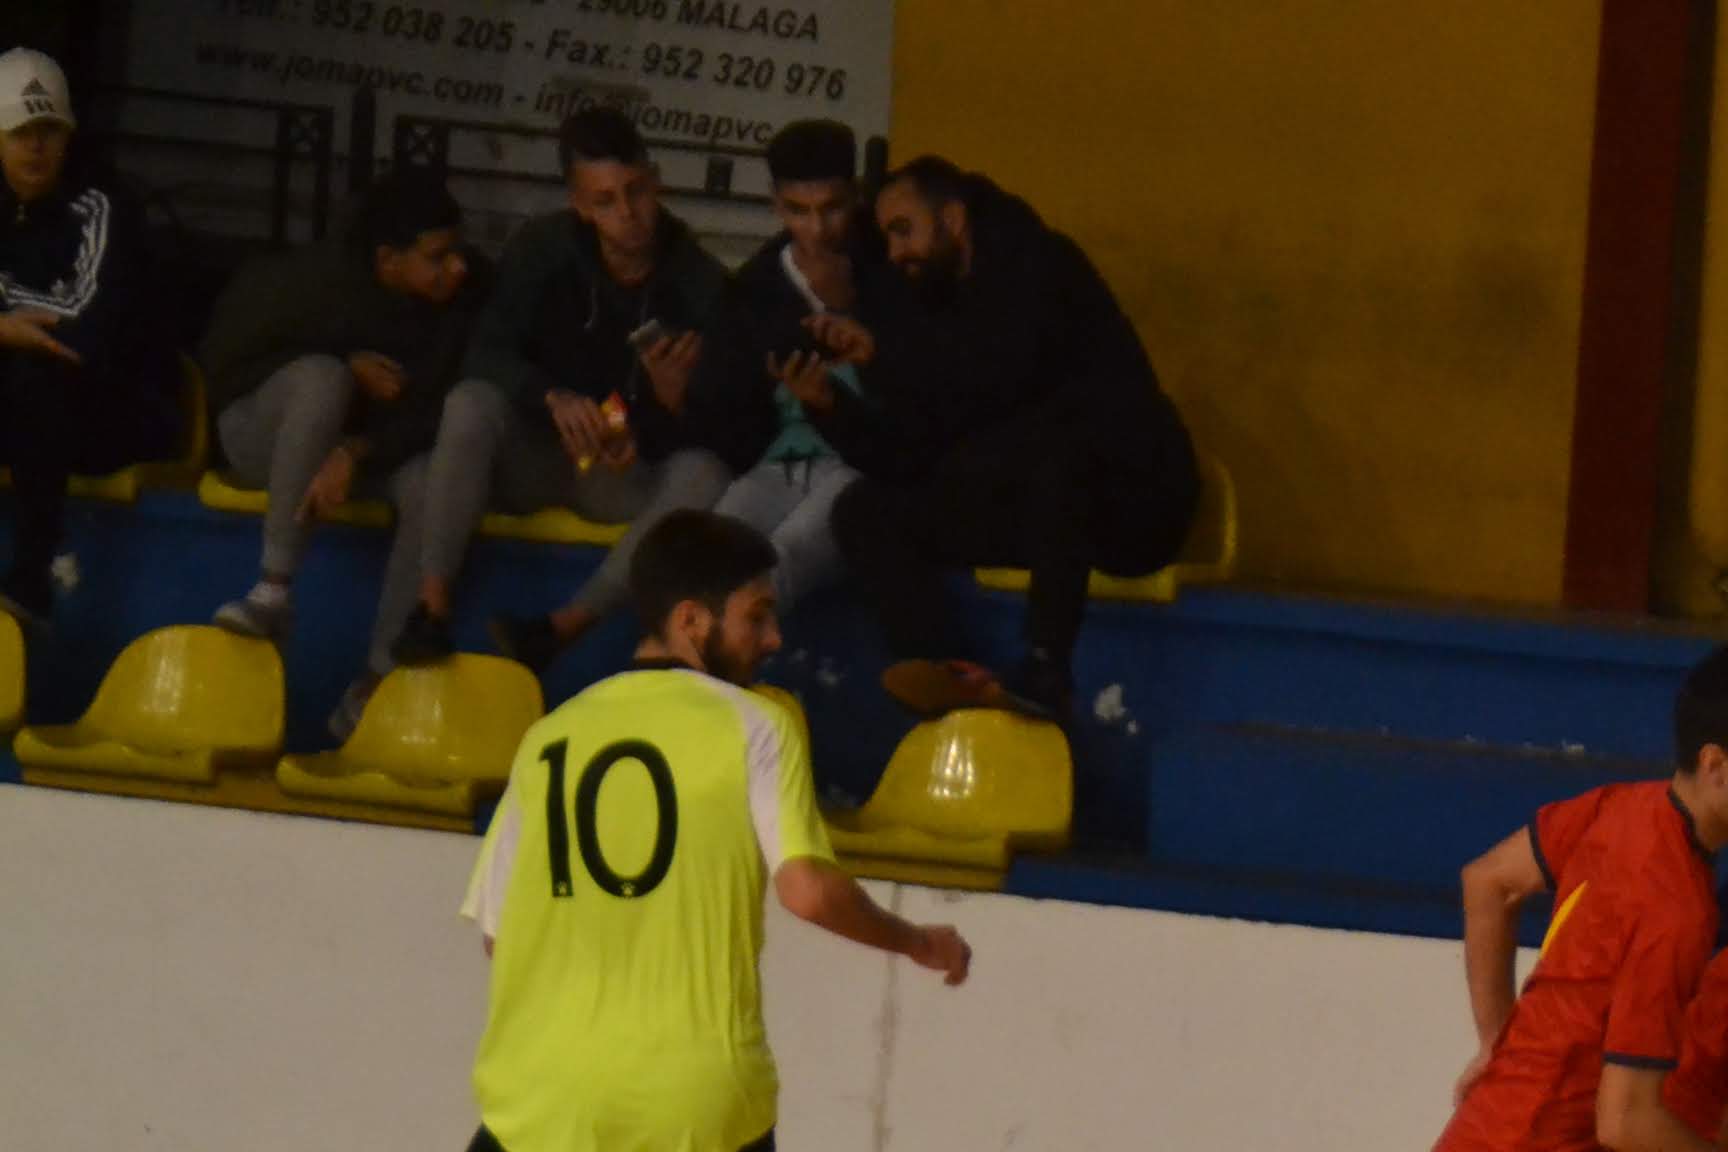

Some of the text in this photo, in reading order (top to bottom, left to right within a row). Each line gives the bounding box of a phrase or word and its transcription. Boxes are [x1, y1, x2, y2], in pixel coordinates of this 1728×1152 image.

[312, 0, 375, 32] 952
[383, 5, 445, 41] 038
[454, 15, 516, 51] 205
[545, 28, 628, 70] Fax.:
[642, 43, 704, 80] 952
[714, 53, 775, 90] 320
[784, 62, 847, 101] 976
[539, 736, 678, 899] 10
